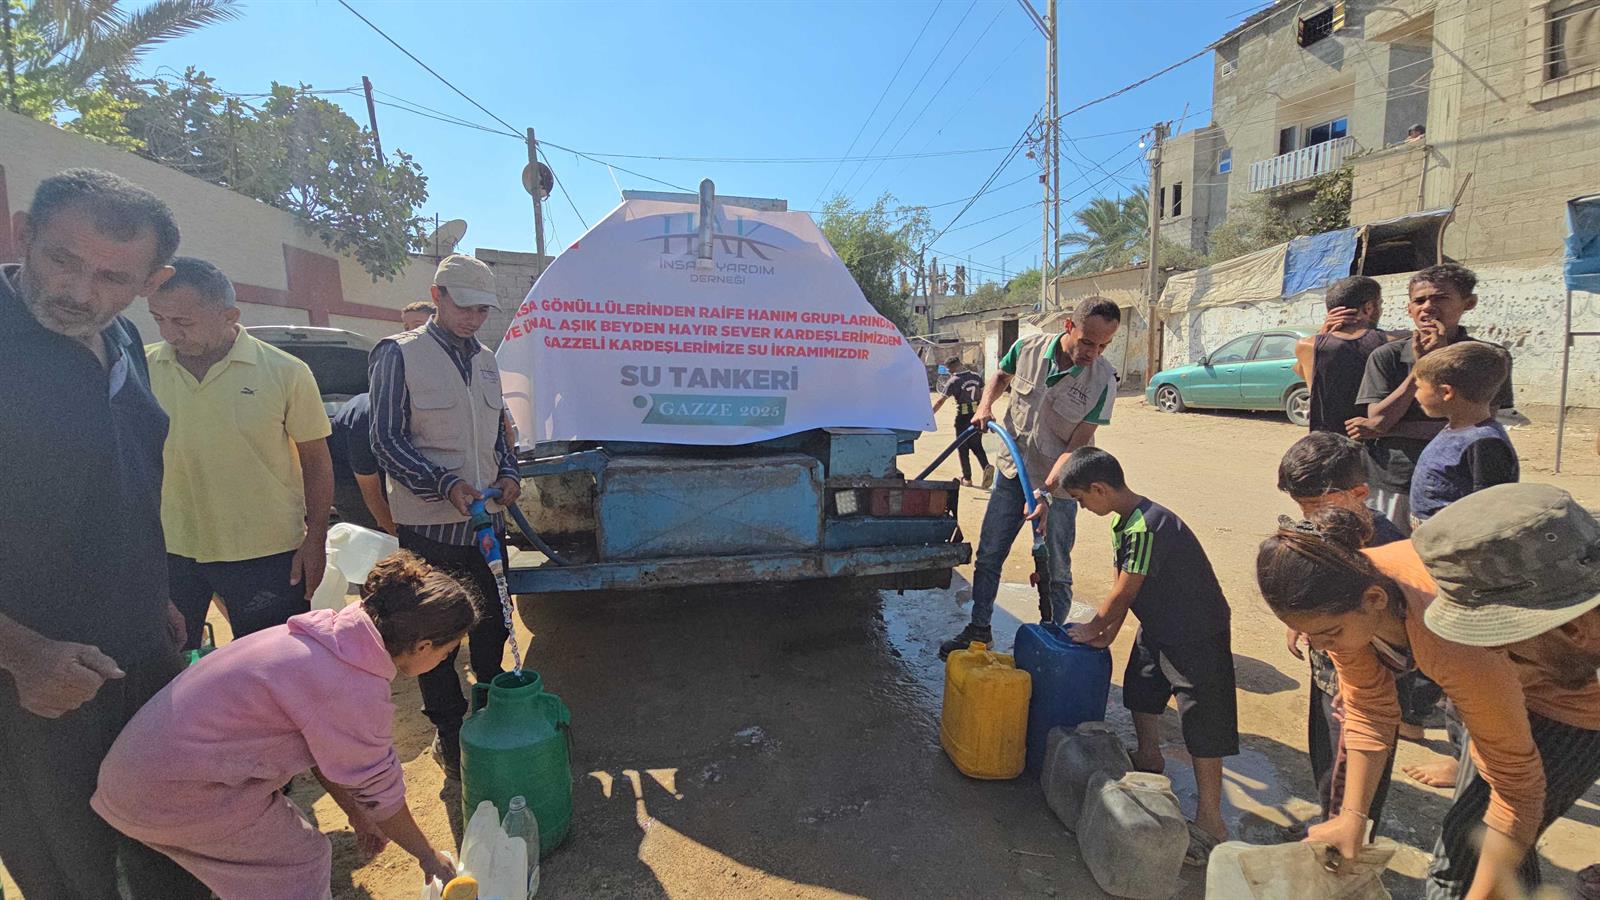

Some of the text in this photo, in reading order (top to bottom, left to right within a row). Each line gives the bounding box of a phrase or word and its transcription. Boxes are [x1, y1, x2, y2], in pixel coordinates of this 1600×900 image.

[659, 256, 775, 275] İNSA YARDIM
[541, 298, 695, 318] GÖNÜLLÜLERİNDEN
[699, 305, 745, 320] RAİFE
[748, 310, 797, 322] HANIM
[523, 317, 556, 334] ÜNAL
[559, 318, 596, 333] AŞIK
[600, 319, 665, 334] BEYDEN
[668, 323, 718, 337] HAYIR
[721, 325, 770, 339] SEVER
[774, 328, 902, 346] KARDEŞLERİMİZDEN
[544, 335, 869, 360] GAZZELİ KARDEŞLERİMİZE SU İKRAMIMIZDIR
[620, 365, 799, 391] SU TANKERİ
[965, 385, 976, 401] 7
[659, 401, 780, 418] GAZZE 2025
